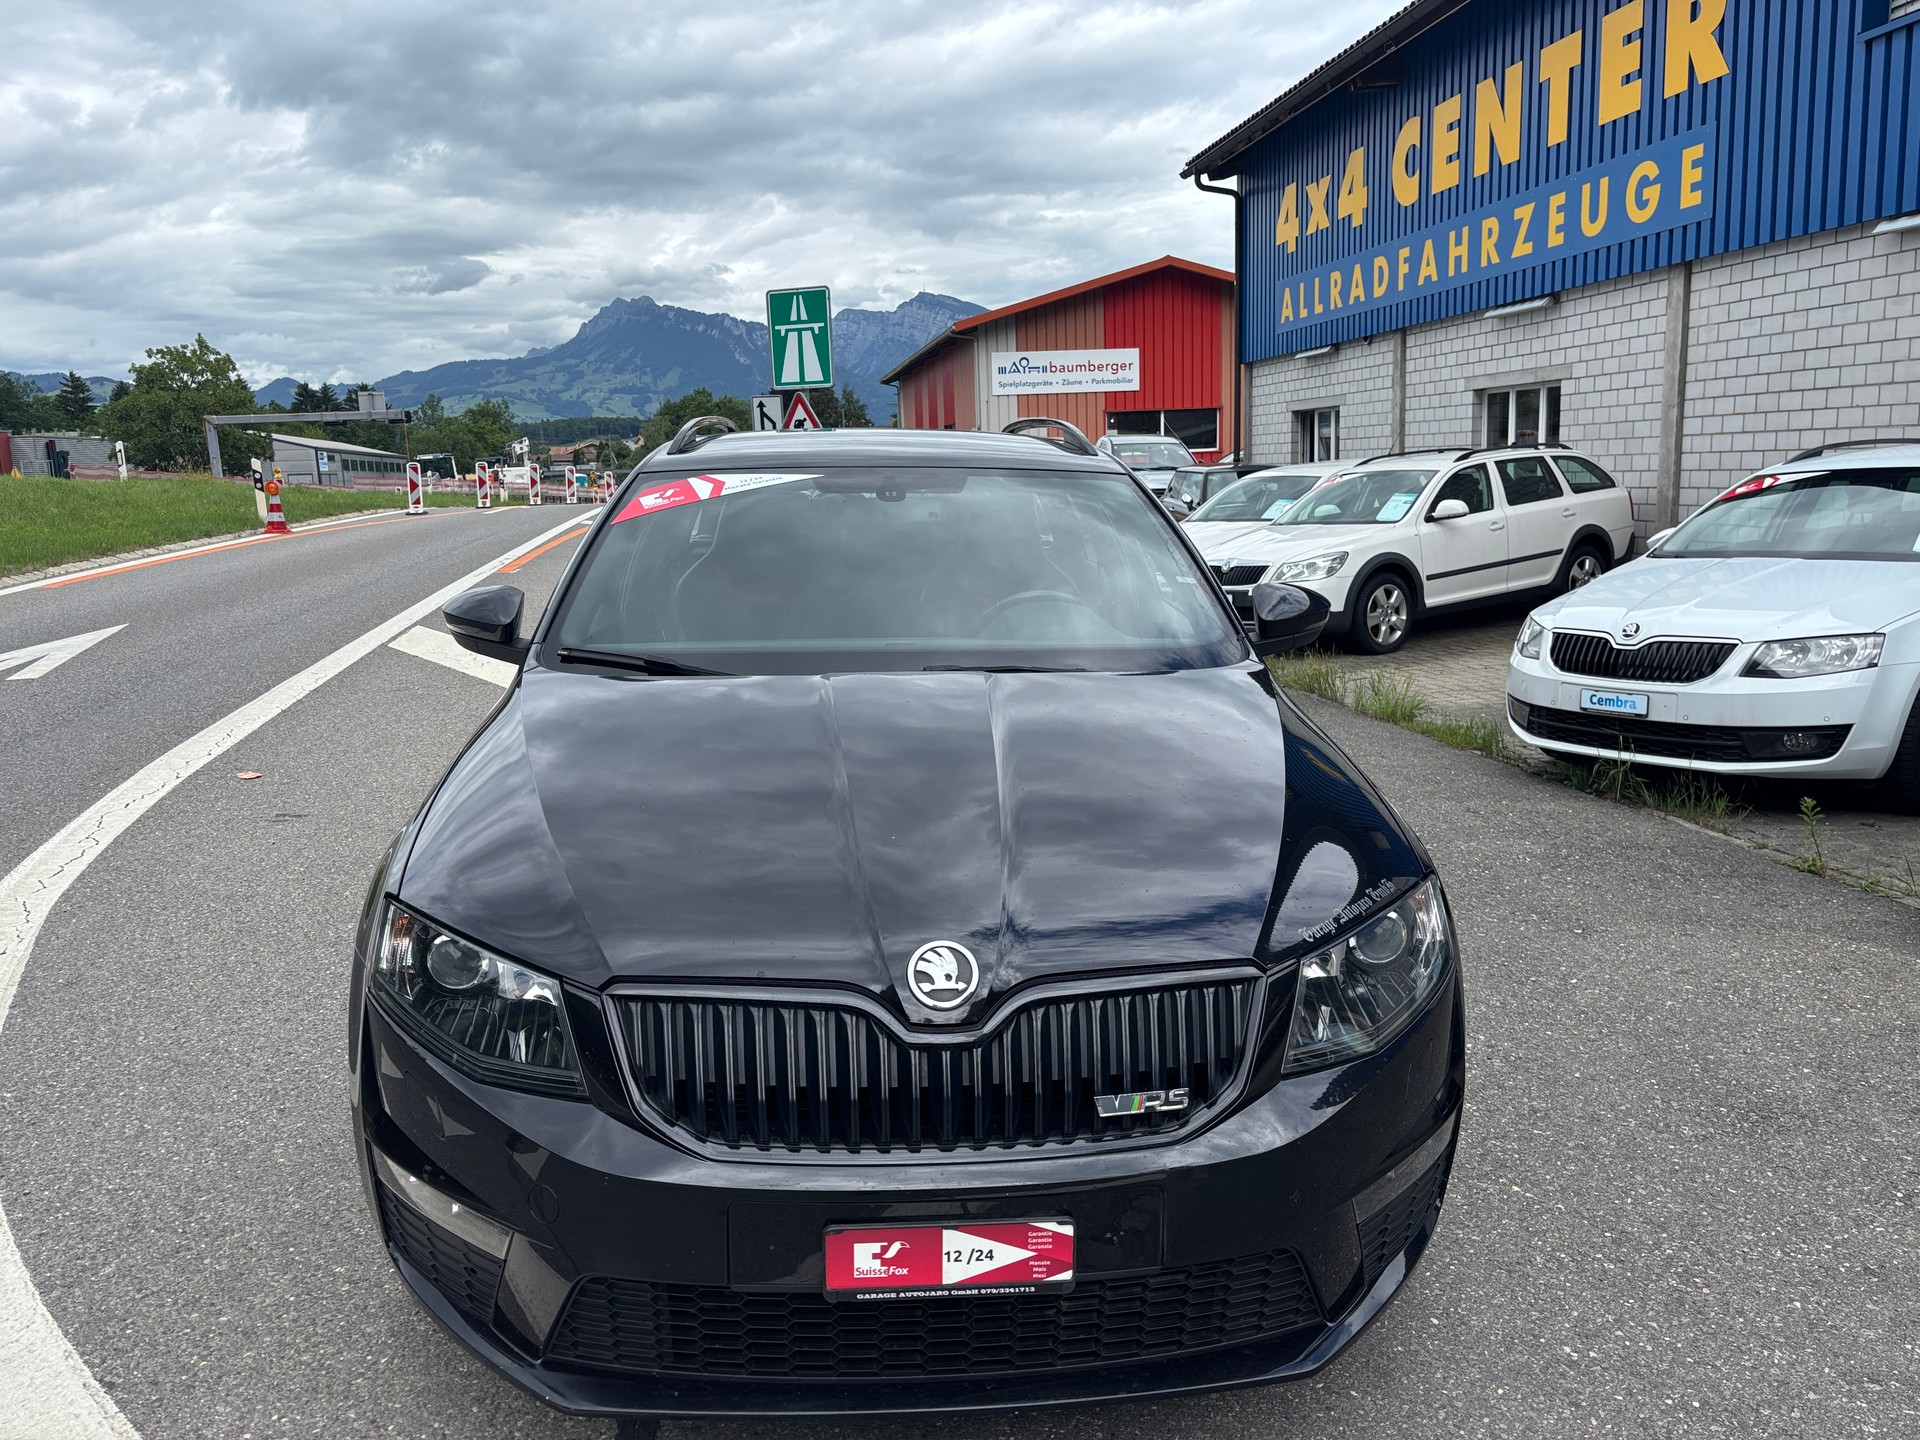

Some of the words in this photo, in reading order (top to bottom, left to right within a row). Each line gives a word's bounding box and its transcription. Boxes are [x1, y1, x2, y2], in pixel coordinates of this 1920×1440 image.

[1276, 146, 1368, 253] 4x4
[1391, 0, 1730, 207] CENTER
[1280, 142, 1704, 325] ALLRADFAHRZEUGE
[1050, 360, 1134, 374] baumberger
[998, 380, 1053, 388] Spielplatzgeräte
[1061, 378, 1082, 386] Zäune
[1091, 377, 1134, 385] Parkmobiliar
[1589, 694, 1637, 709] Cembra
[944, 1250, 962, 1262] 12
[857, 1292, 896, 1300] GARAGE
[899, 1290, 949, 1298] AUTOJARO
[951, 1288, 978, 1296] GmbH
